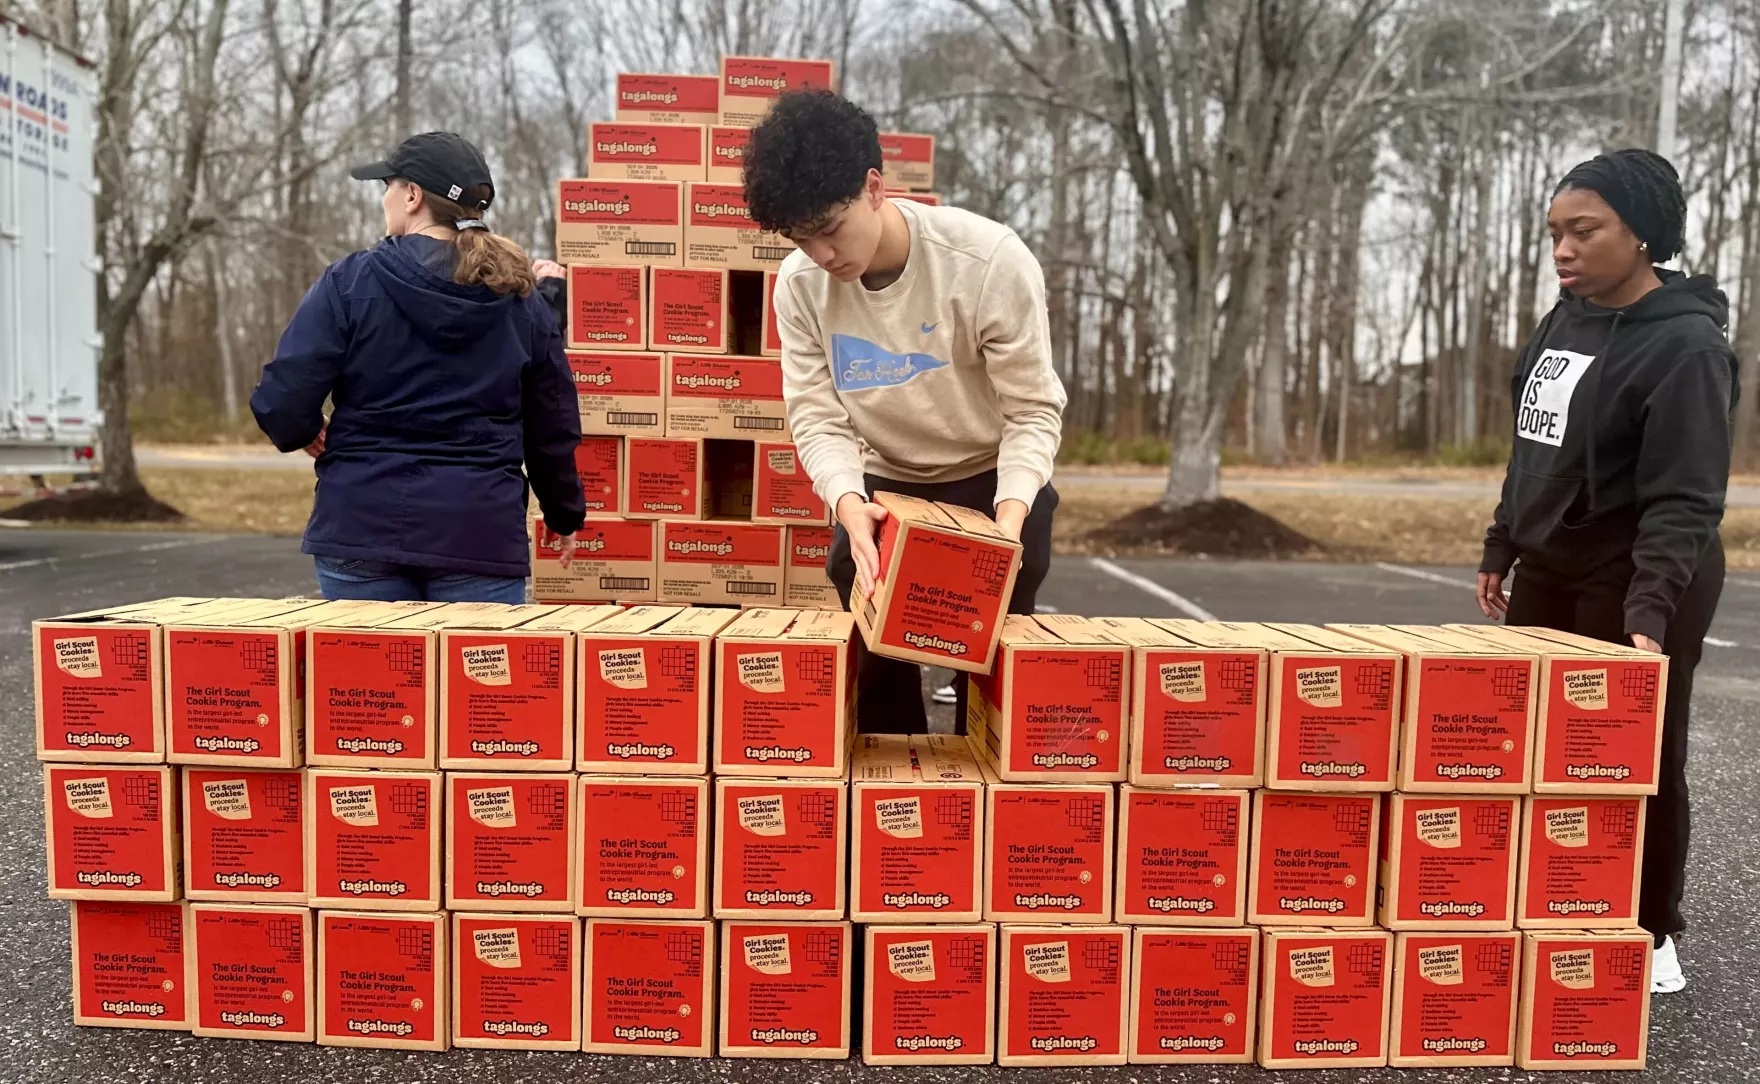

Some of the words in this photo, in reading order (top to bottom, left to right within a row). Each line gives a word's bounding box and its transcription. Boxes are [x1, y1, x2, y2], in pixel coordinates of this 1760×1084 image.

[728, 74, 787, 89] tagalongs
[621, 90, 678, 104] tagalongs
[596, 141, 657, 156] tagalongs
[564, 199, 631, 215] tagalongs
[694, 201, 751, 219] tagalong
[587, 331, 628, 342] tagalongs
[667, 333, 708, 344] tagalongs
[1534, 356, 1570, 380] GOD
[675, 374, 741, 390] tagalongs
[1524, 380, 1542, 405] IS
[1520, 406, 1559, 440] DOPE.
[643, 501, 683, 512] tagalongs
[771, 505, 811, 517] tagalongs
[668, 539, 733, 555] tagalongs
[795, 544, 829, 559] tagal
[907, 593, 937, 605] Cookie
[910, 583, 925, 592] The
[928, 587, 944, 597] Girl
[946, 590, 972, 603] Scout
[905, 632, 967, 654] tagalongs
[61, 656, 89, 664] proceeds
[744, 671, 772, 679] proceeds
[1565, 674, 1579, 682] Girl
[186, 687, 202, 695] The
[205, 687, 222, 696] Girl
[225, 688, 250, 697] Scout
[186, 697, 217, 705] Cookie
[66, 732, 130, 748] tagalongs
[195, 737, 259, 753] tagalongs
[337, 738, 403, 754] tagalongs
[471, 740, 538, 755] tagalongs
[608, 743, 673, 759] tagalongs
[745, 747, 811, 762] tagalongs
[1033, 753, 1097, 768] tagalongs
[1165, 756, 1230, 771] tagalongs
[1301, 762, 1365, 777] tagalongs
[1437, 764, 1501, 779] tagalongs
[1567, 764, 1630, 780] tagalongs
[881, 816, 911, 825] proceeds
[600, 840, 617, 848] The
[620, 840, 637, 848] Girl
[600, 850, 632, 858] Cookie
[1275, 849, 1291, 857] The
[1294, 849, 1311, 857] Girl
[1314, 850, 1340, 858] Scout
[1274, 859, 1305, 867] Cookie
[77, 871, 141, 887] tagalongs
[215, 872, 280, 888] tagalongs
[340, 880, 406, 895] tagalongs
[477, 881, 543, 897] tagalongs
[607, 889, 673, 904] tagalongs
[746, 890, 812, 905] tagalongs
[884, 893, 949, 908] tagalongs
[1015, 894, 1081, 909] tagalongs
[1148, 897, 1214, 912] tagalongs
[1280, 897, 1344, 913] tagalongs
[1421, 901, 1484, 917] tagalongs
[1548, 900, 1610, 914] tagalongs
[1025, 947, 1040, 955] Girl
[1552, 954, 1566, 962] Girl
[1030, 961, 1058, 970] proceeds
[1555, 968, 1583, 976] proceeds
[340, 971, 356, 979] The
[359, 972, 376, 980] Girl
[379, 973, 405, 982] Scout
[340, 981, 371, 989] Cookie
[102, 1001, 164, 1016] tagalongs
[221, 1011, 284, 1027] tagalongs
[348, 1019, 412, 1036] tagalongs
[484, 1021, 548, 1036] tagalongs
[614, 1026, 679, 1042] tagalongs
[752, 1028, 817, 1044] tagalongs
[896, 1035, 962, 1051] tagalongs
[1031, 1036, 1096, 1051] tagalongs
[1160, 1036, 1224, 1051] tagalongs
[1295, 1039, 1358, 1054] tagalongs
[1423, 1037, 1486, 1052] tagalongs
[1554, 1041, 1616, 1056] tagalongs
